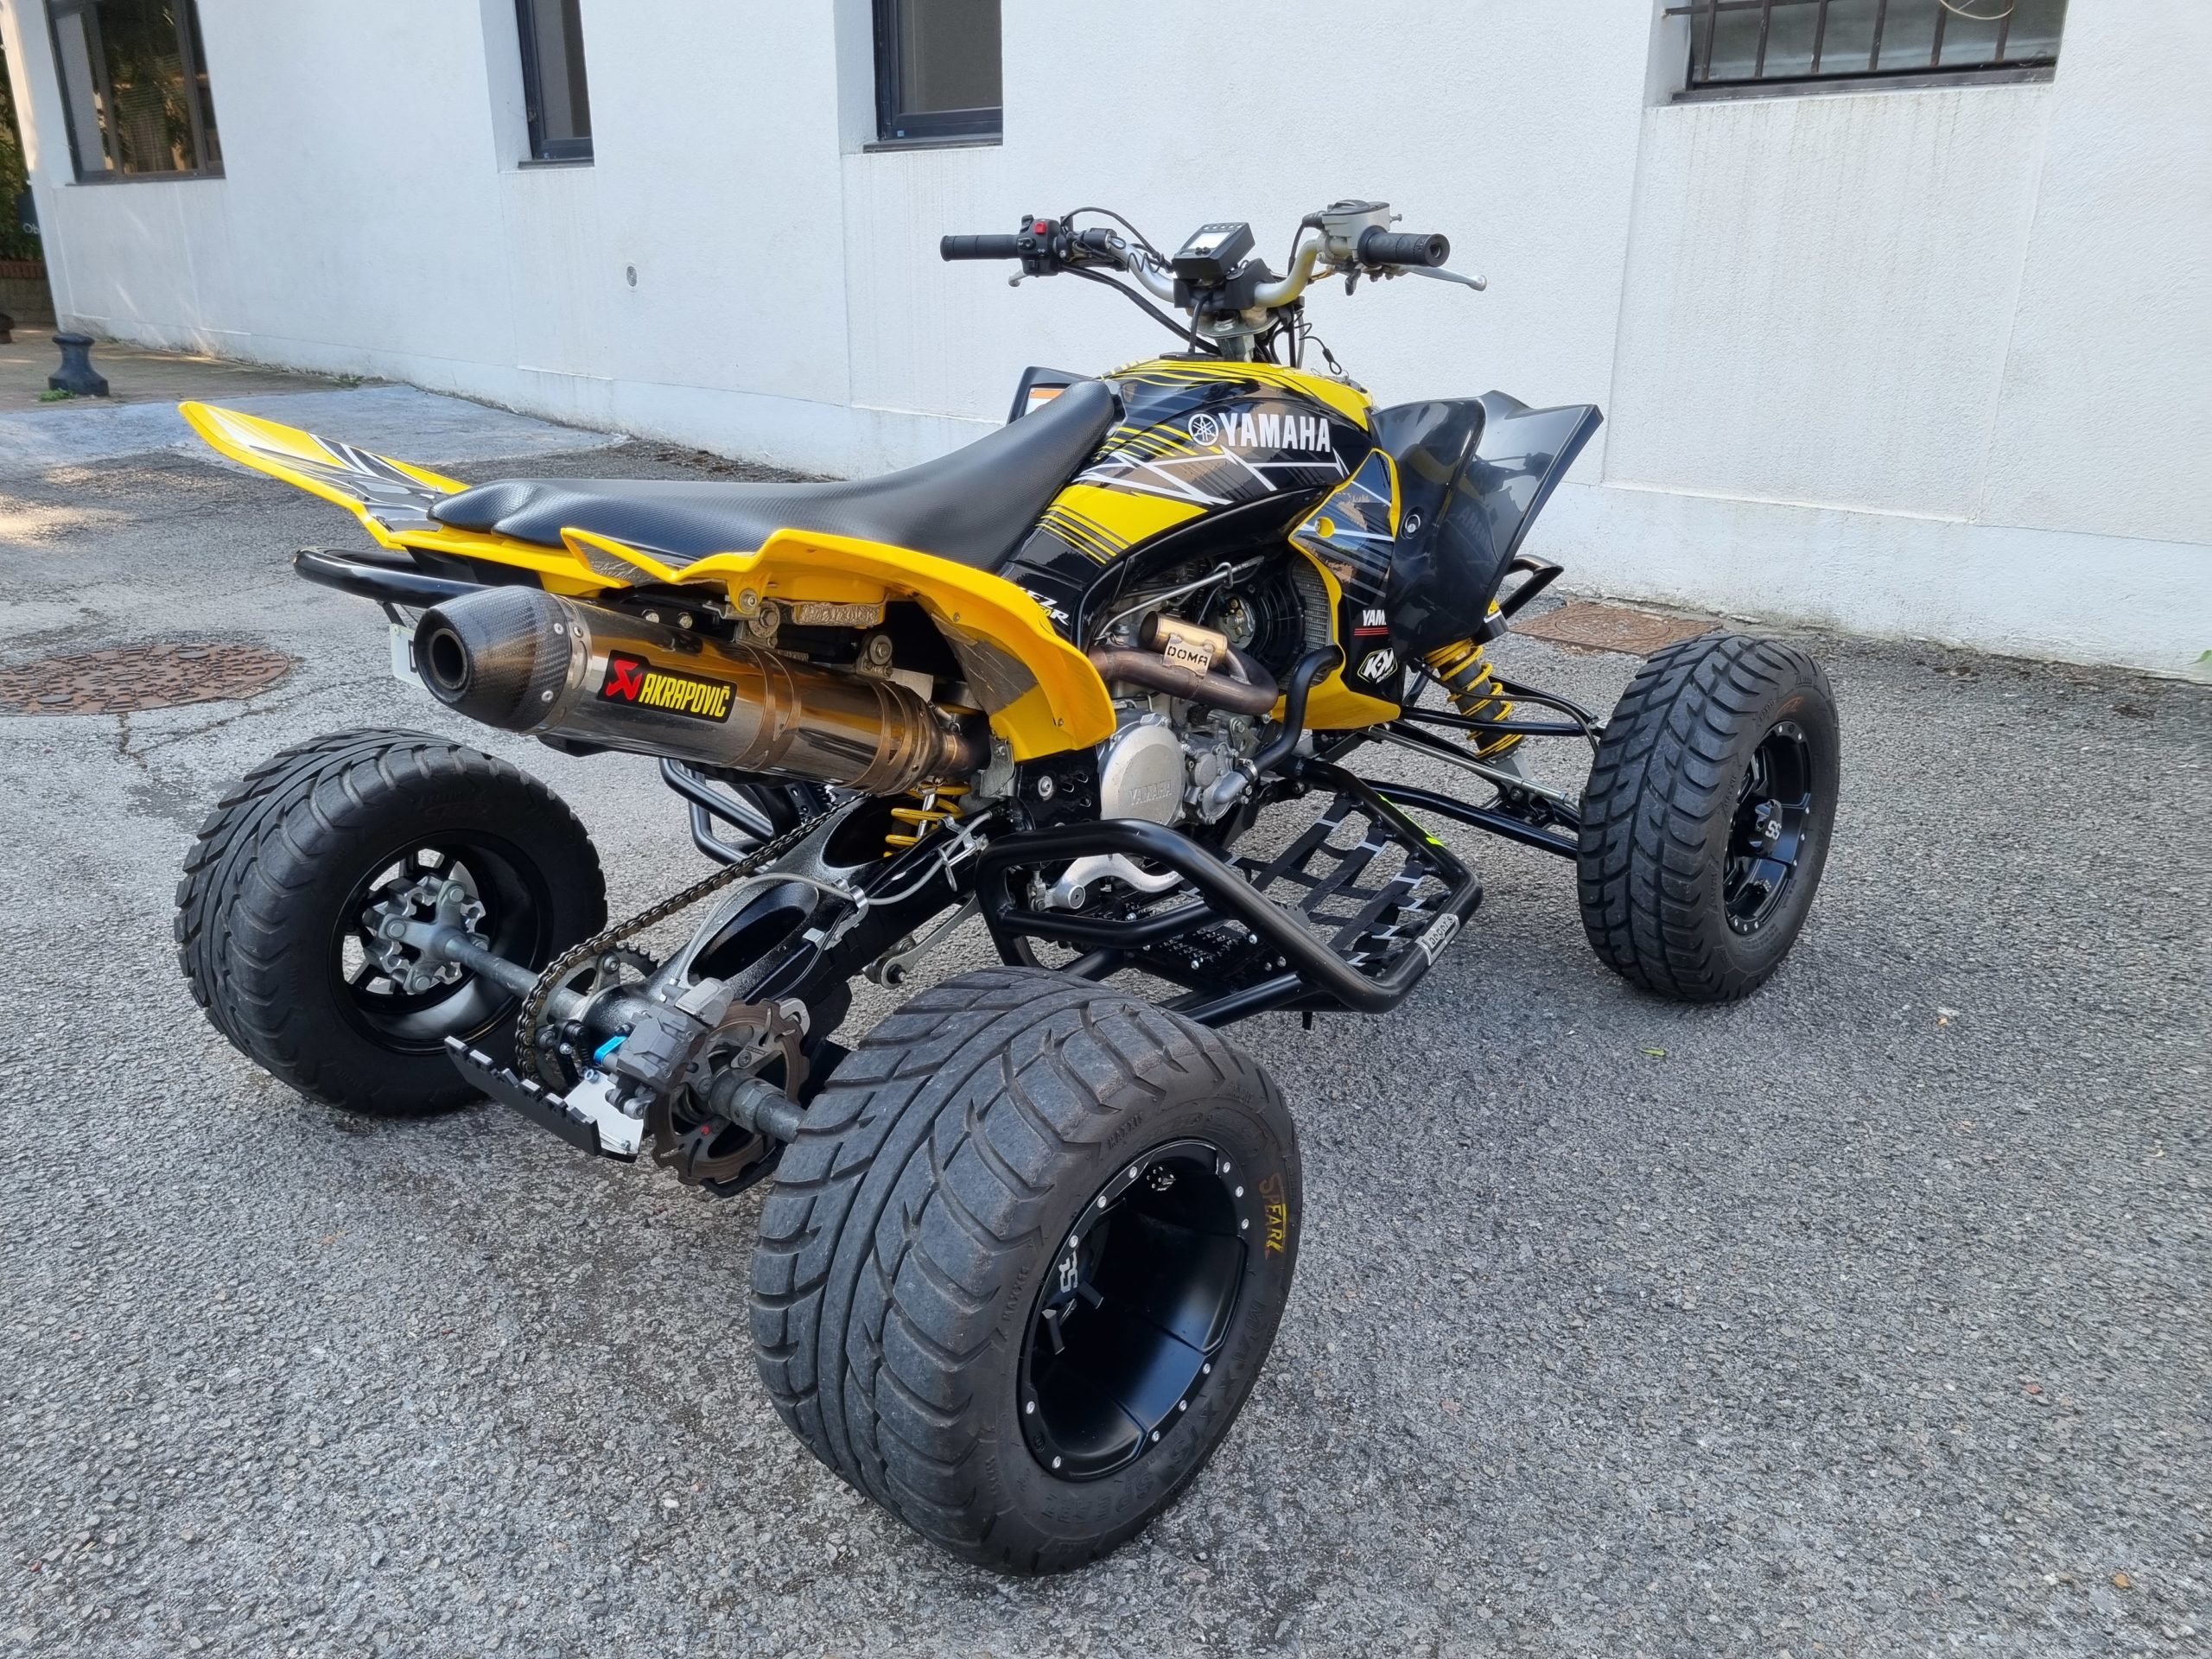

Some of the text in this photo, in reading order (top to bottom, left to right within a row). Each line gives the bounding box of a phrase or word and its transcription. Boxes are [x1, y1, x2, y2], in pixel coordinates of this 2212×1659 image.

[1218, 413, 1331, 453] YAMAHA
[1020, 587, 1058, 610] FZ
[1363, 609, 1387, 626] YAM
[1166, 645, 1208, 666] DOMA
[1128, 779, 1173, 806] YAMAHA
